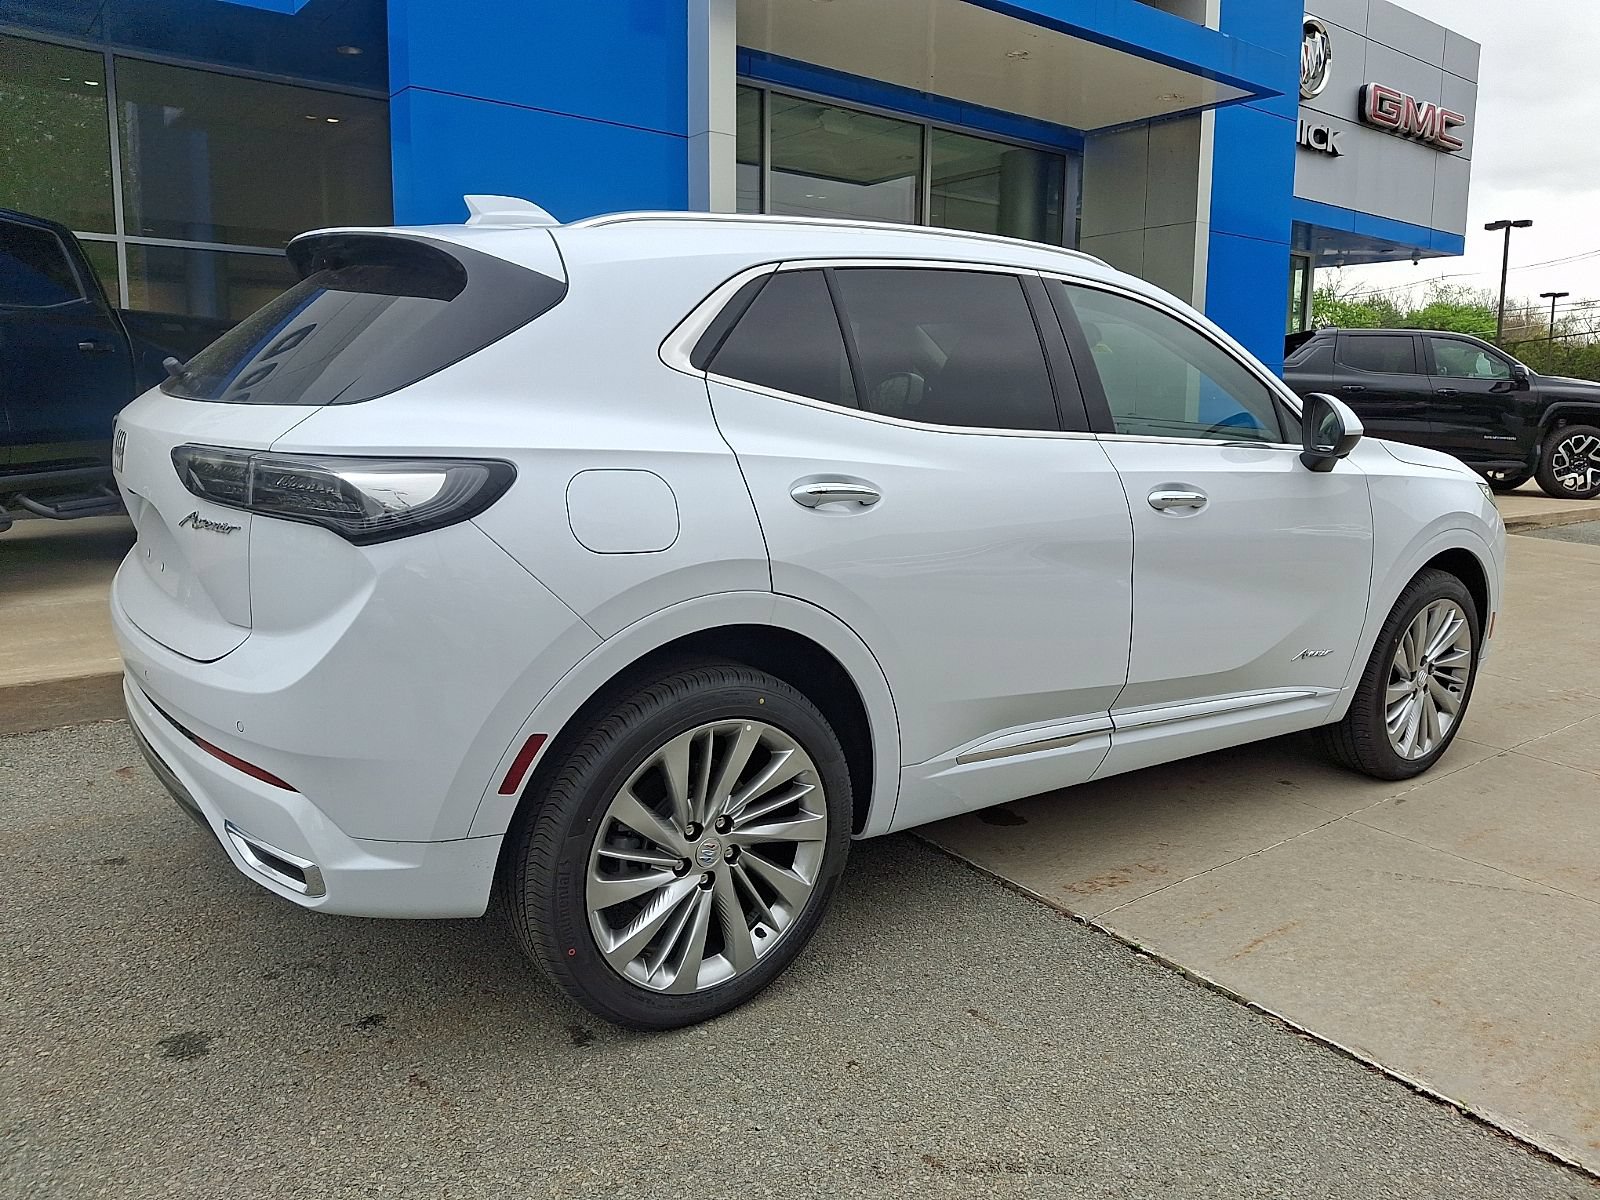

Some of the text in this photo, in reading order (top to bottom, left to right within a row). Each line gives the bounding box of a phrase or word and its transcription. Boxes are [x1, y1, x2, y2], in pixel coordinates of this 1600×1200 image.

[1360, 82, 1466, 152] GMC
[1295, 118, 1347, 156] ICK
[178, 511, 242, 535] Avenir
